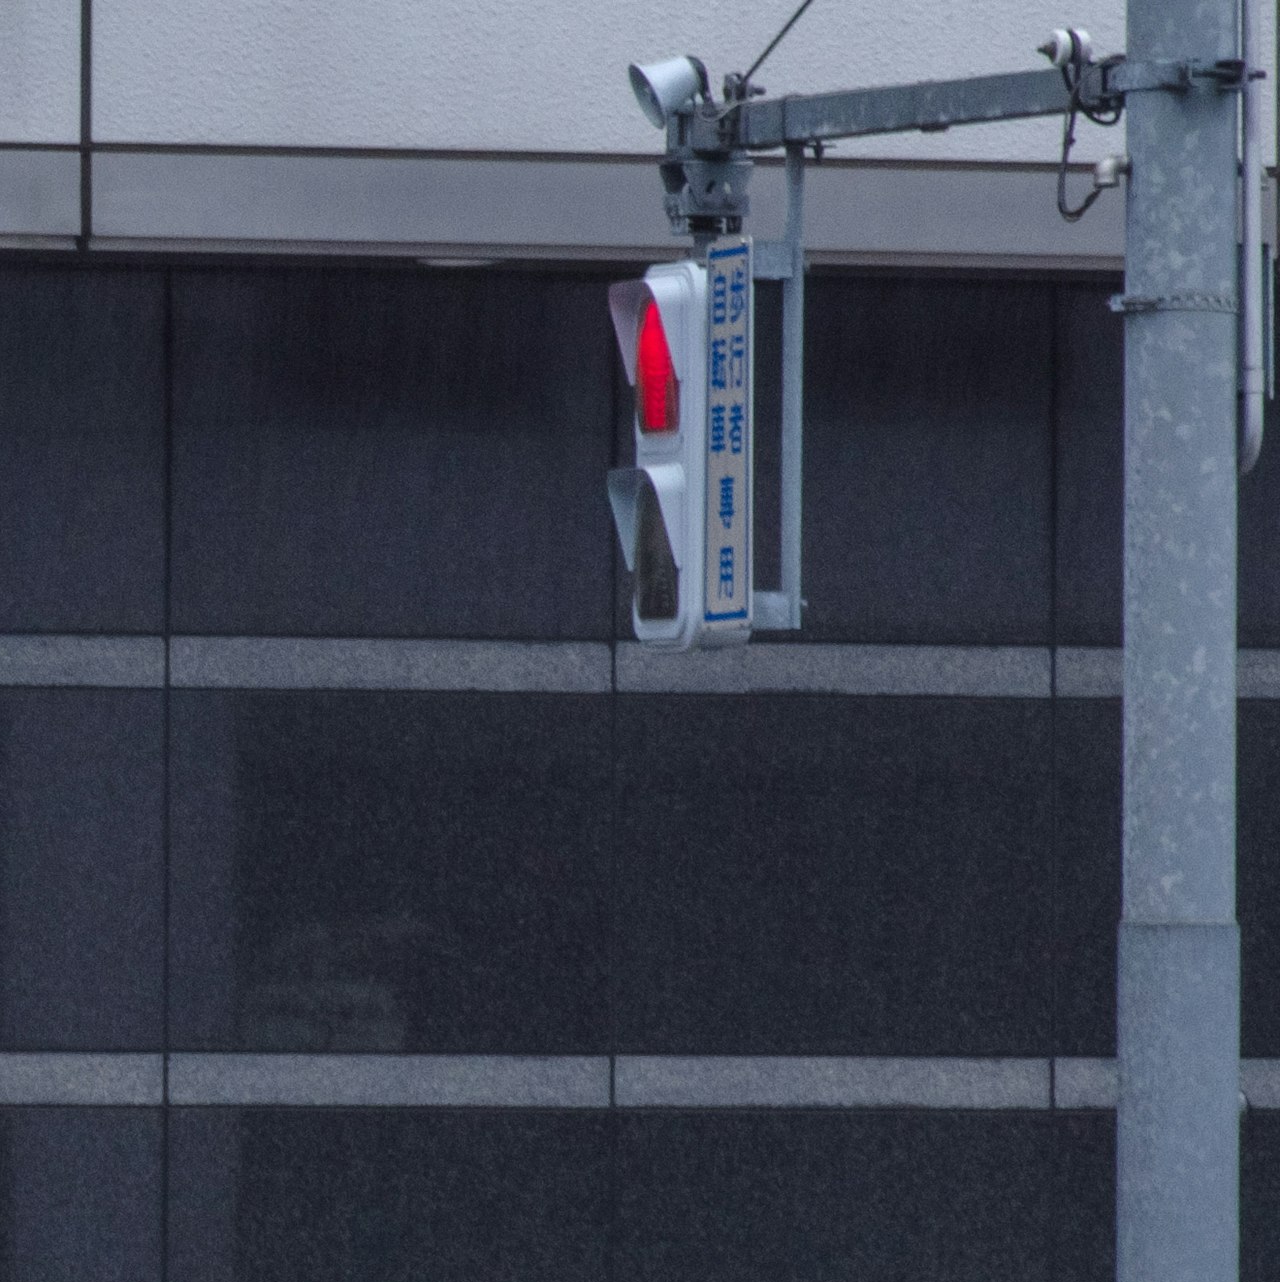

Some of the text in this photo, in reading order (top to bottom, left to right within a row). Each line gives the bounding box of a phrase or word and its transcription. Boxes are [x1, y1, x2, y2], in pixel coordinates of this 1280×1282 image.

[710, 272, 727, 454] 自転車
[729, 270, 745, 454] 歩行者
[719, 474, 735, 600] 専用
